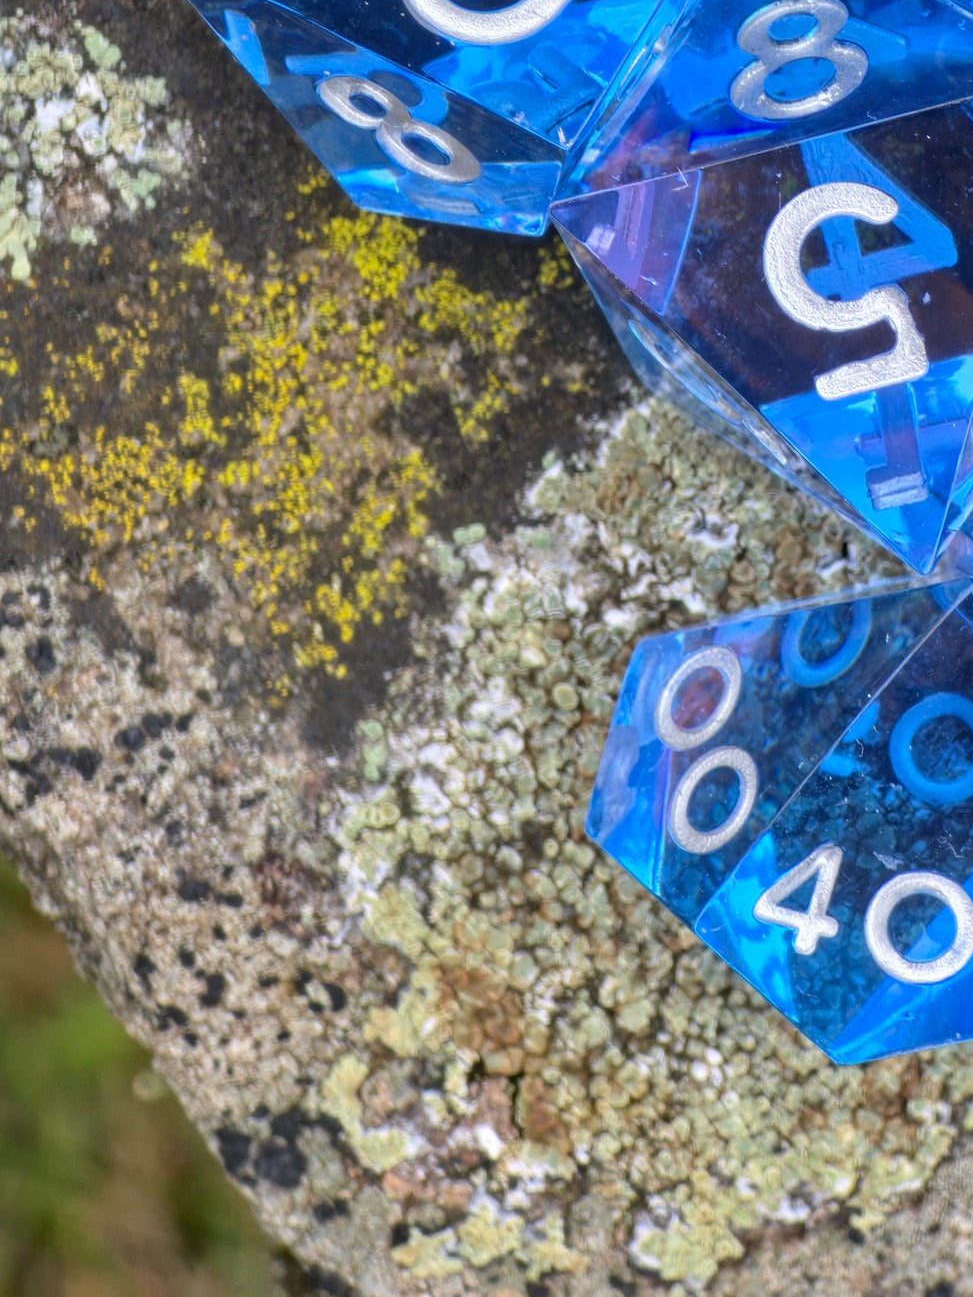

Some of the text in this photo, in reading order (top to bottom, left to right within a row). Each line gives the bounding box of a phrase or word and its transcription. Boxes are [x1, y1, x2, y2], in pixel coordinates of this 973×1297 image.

[314, 75, 482, 185] 8
[762, 181, 930, 402] 5
[652, 644, 761, 855] 00
